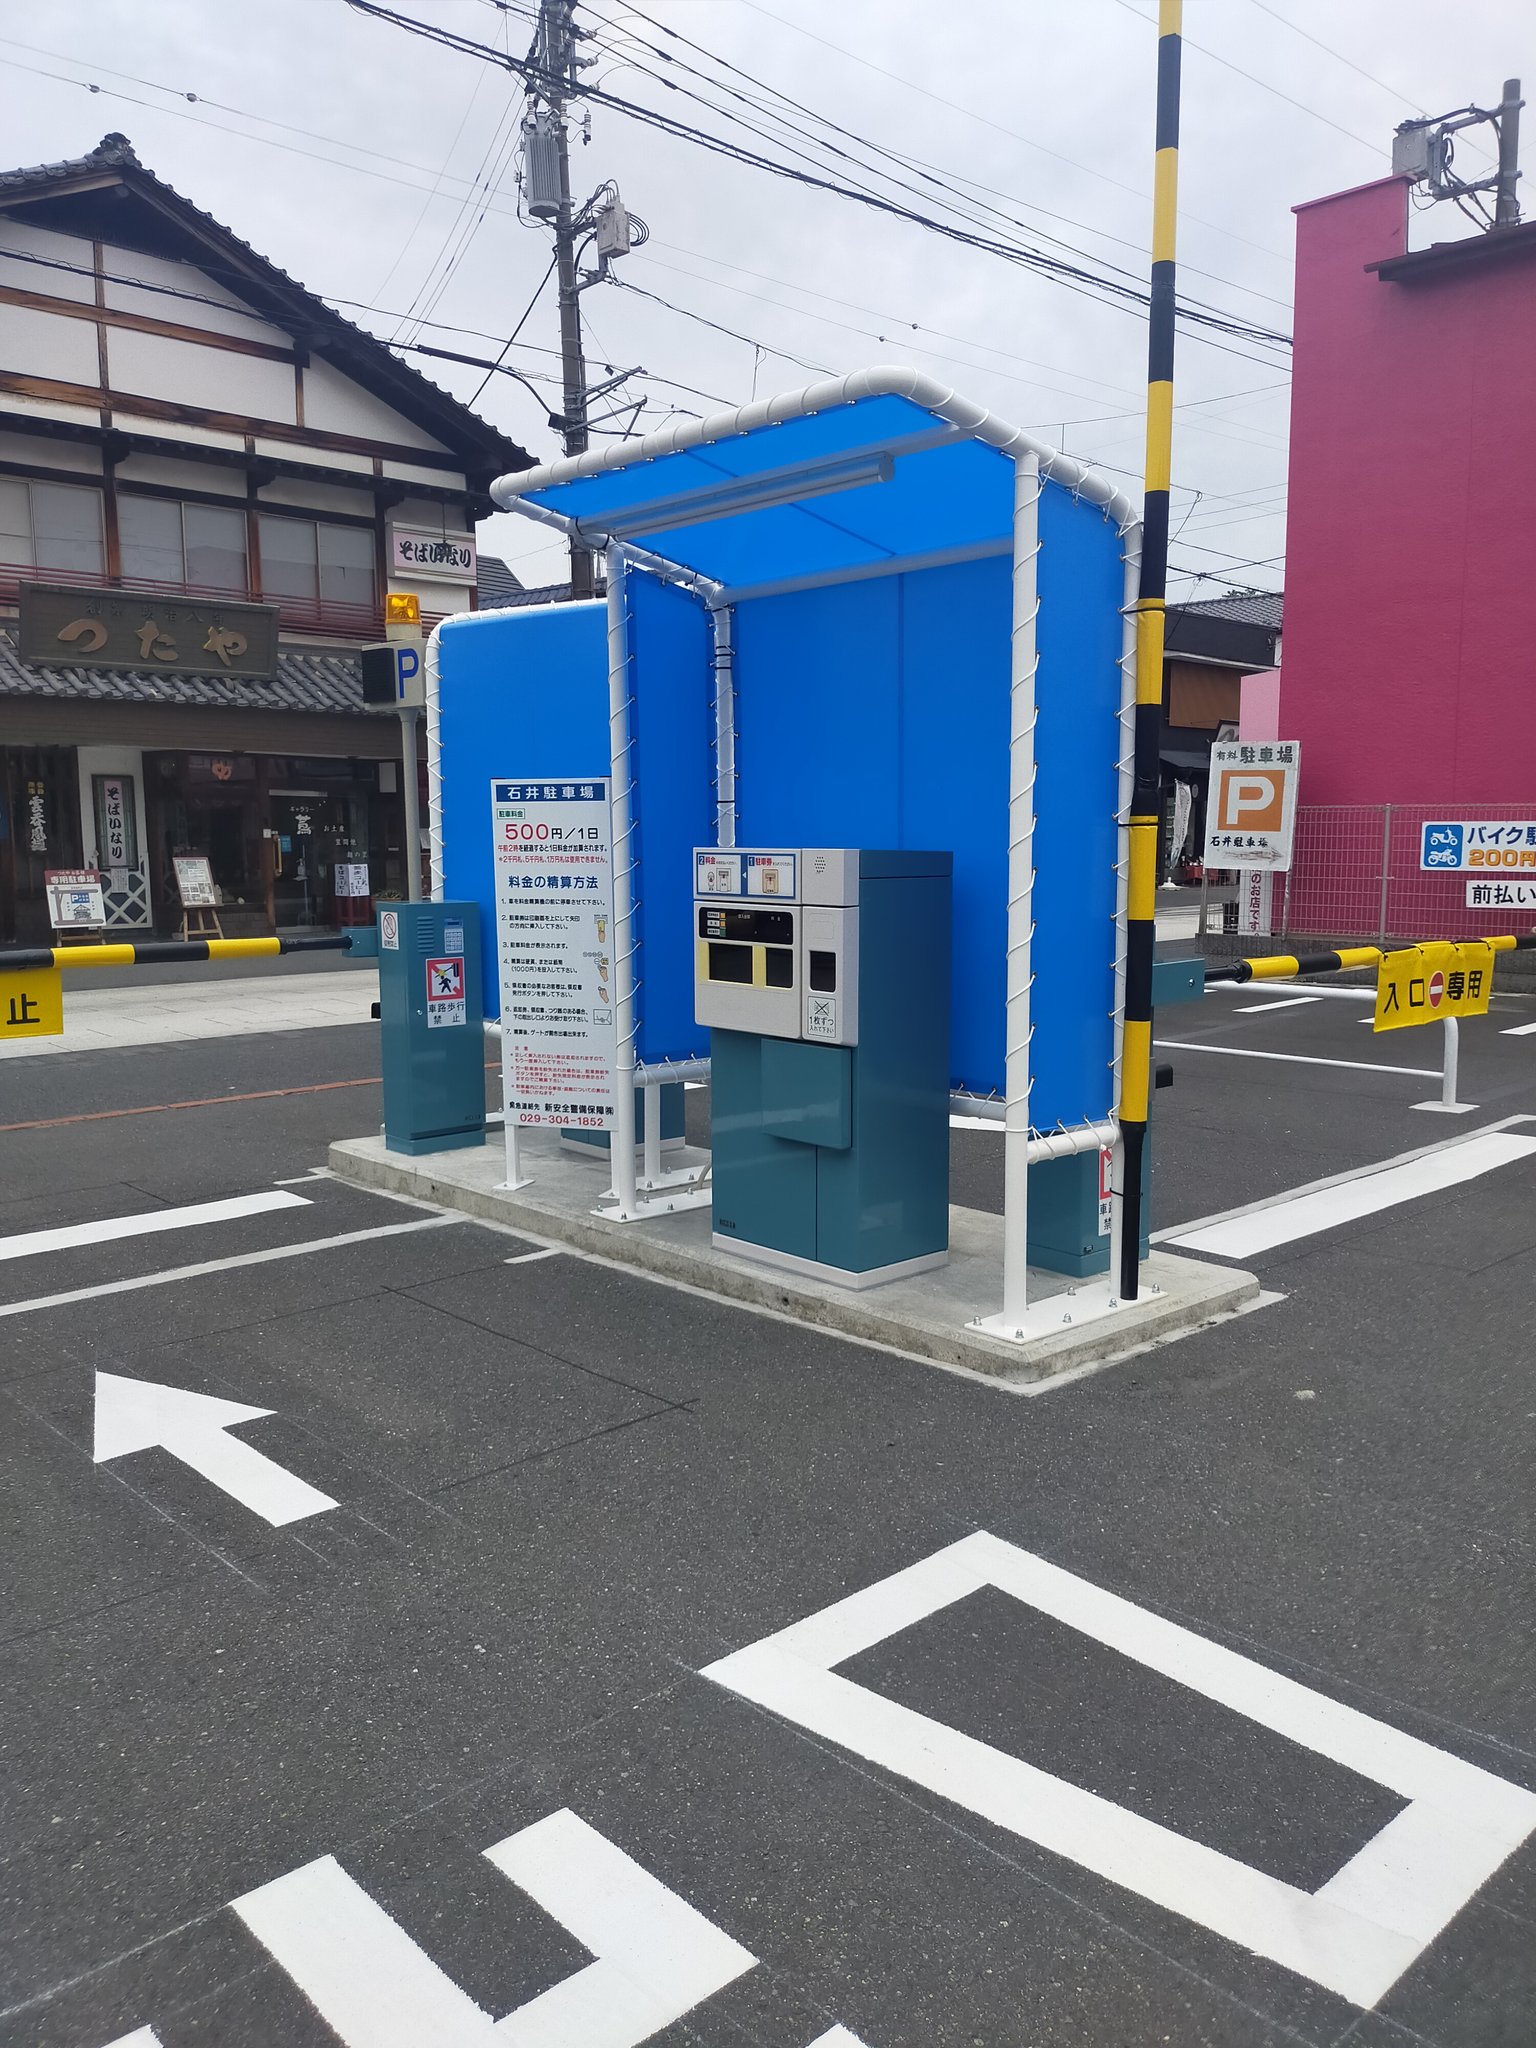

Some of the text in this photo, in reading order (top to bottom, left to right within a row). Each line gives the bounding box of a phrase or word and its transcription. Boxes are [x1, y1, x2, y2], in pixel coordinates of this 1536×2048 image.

[57, 618, 248, 667] つたや
[398, 648, 419, 699] P
[507, 786, 594, 799] 石井駐車場
[1226, 775, 1275, 825] P
[499, 810, 524, 818] 駐車料金
[106, 787, 123, 859] そばいなり
[323, 825, 345, 833] お土産
[1210, 836, 1269, 848] 石井駐車場
[705, 856, 716, 865] 料金
[1468, 849, 1536, 867] 200円
[50, 874, 95, 884] 専用駐車場
[508, 875, 599, 889] 料金の精算方法
[72, 894, 79, 902] P
[1472, 884, 1536, 904] 前払い
[1248, 870, 1262, 936] のお店です。
[1384, 969, 1483, 1014] 入口 専用
[6, 993, 41, 1025] 止
[428, 1001, 465, 1013] 車路歩行
[434, 1013, 461, 1025] 禁止
[809, 1015, 835, 1026] 1枚ずつ
[509, 1101, 540, 1111] 緊急連絡先
[520, 1113, 604, 1127] 029-304-1852
